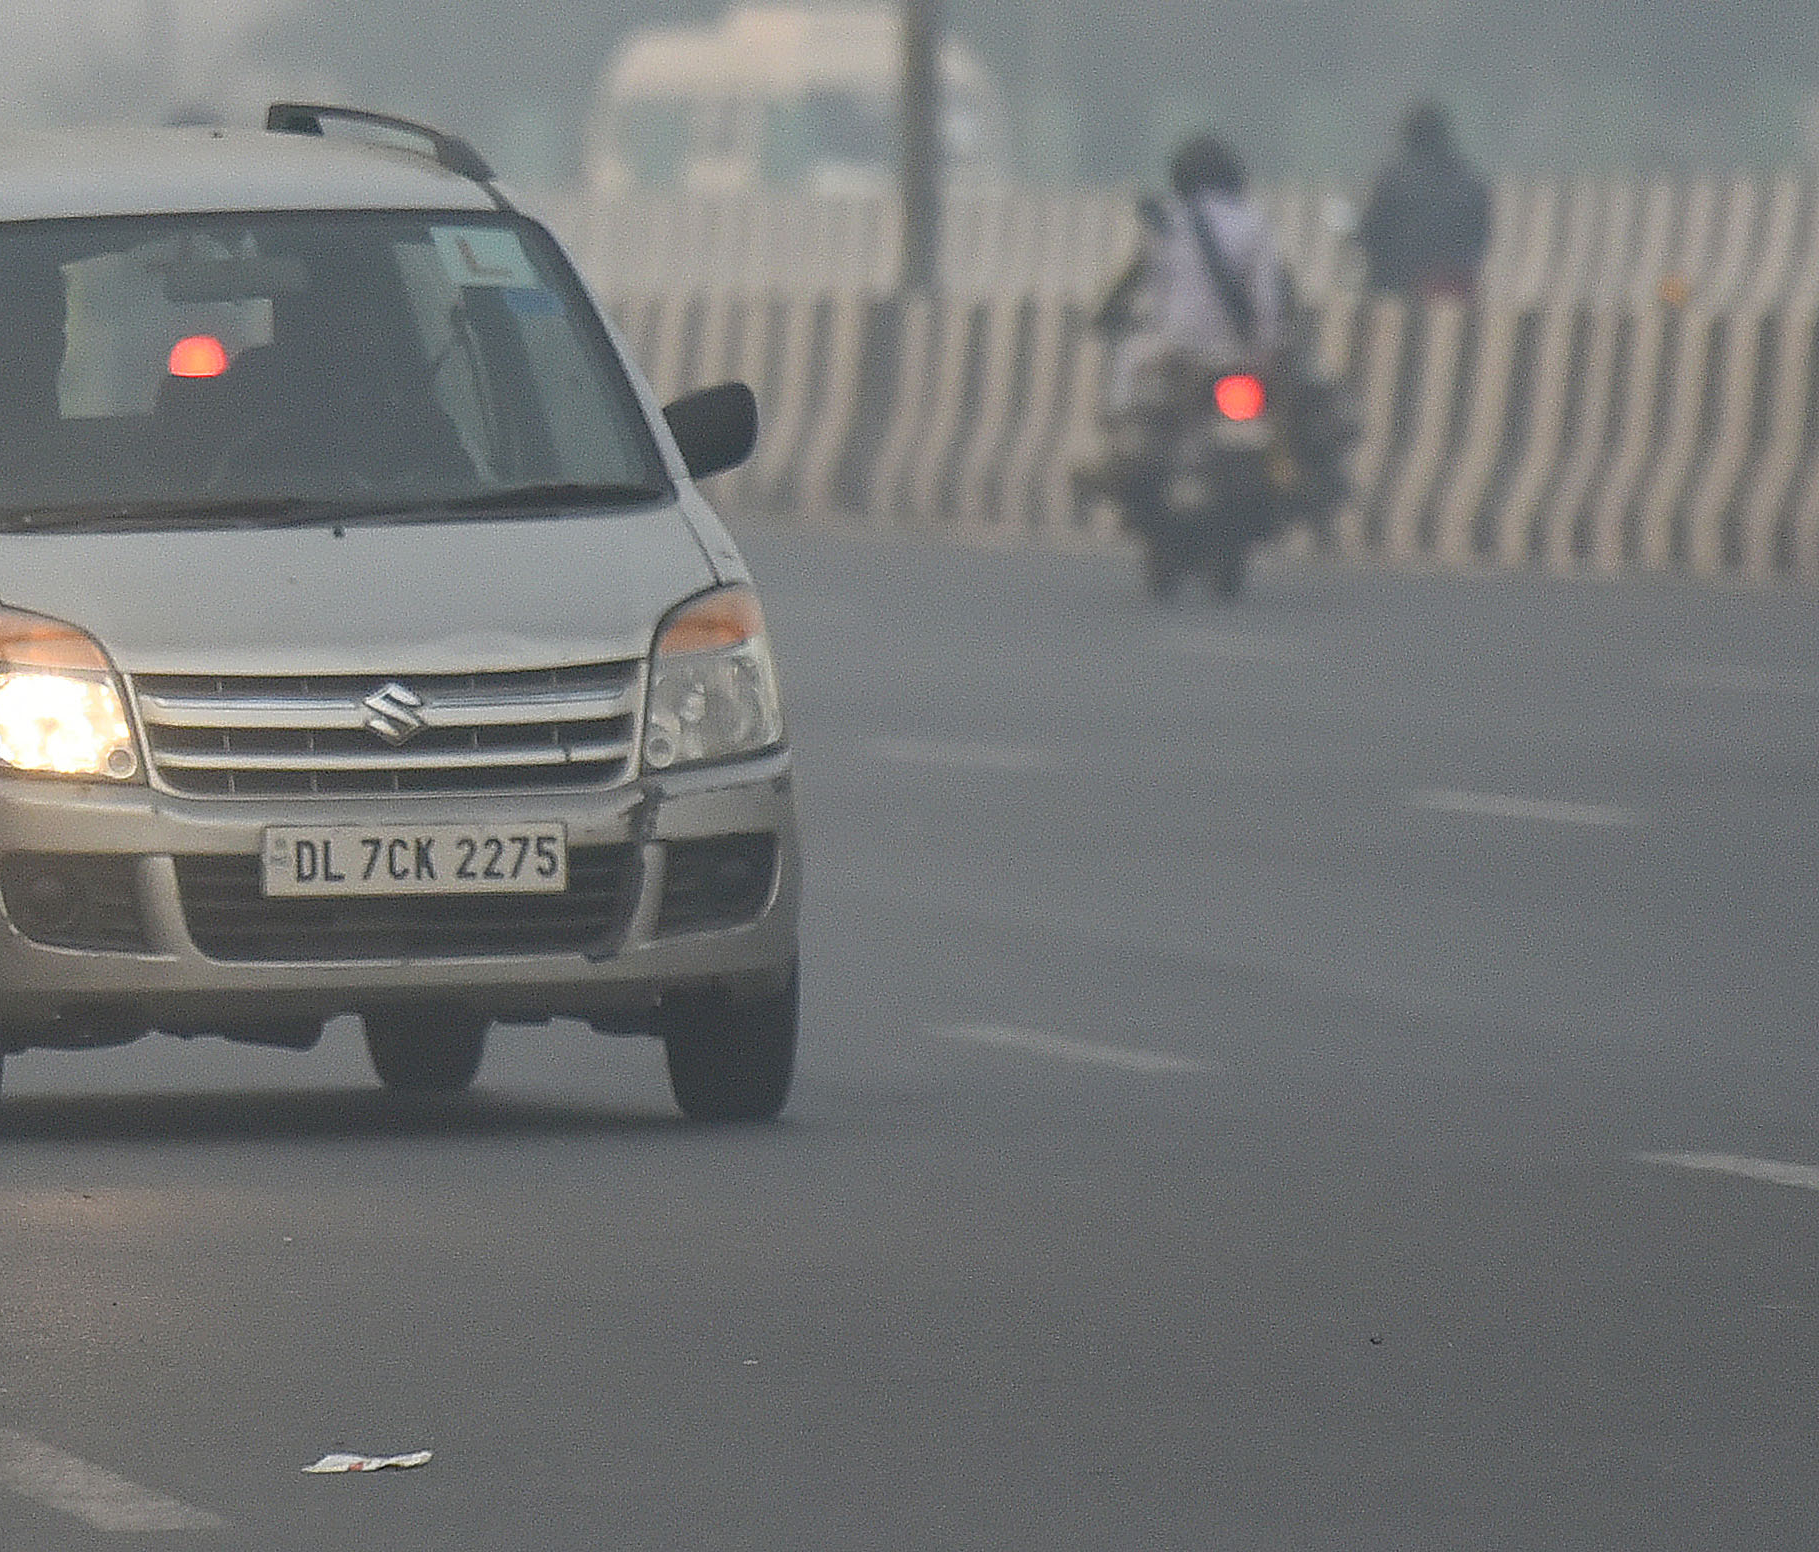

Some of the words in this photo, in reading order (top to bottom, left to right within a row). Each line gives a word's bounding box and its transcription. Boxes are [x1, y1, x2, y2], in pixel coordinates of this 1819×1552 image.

[295, 839, 345, 882] DL
[362, 837, 438, 881] 7CK
[455, 836, 559, 880] 2275
